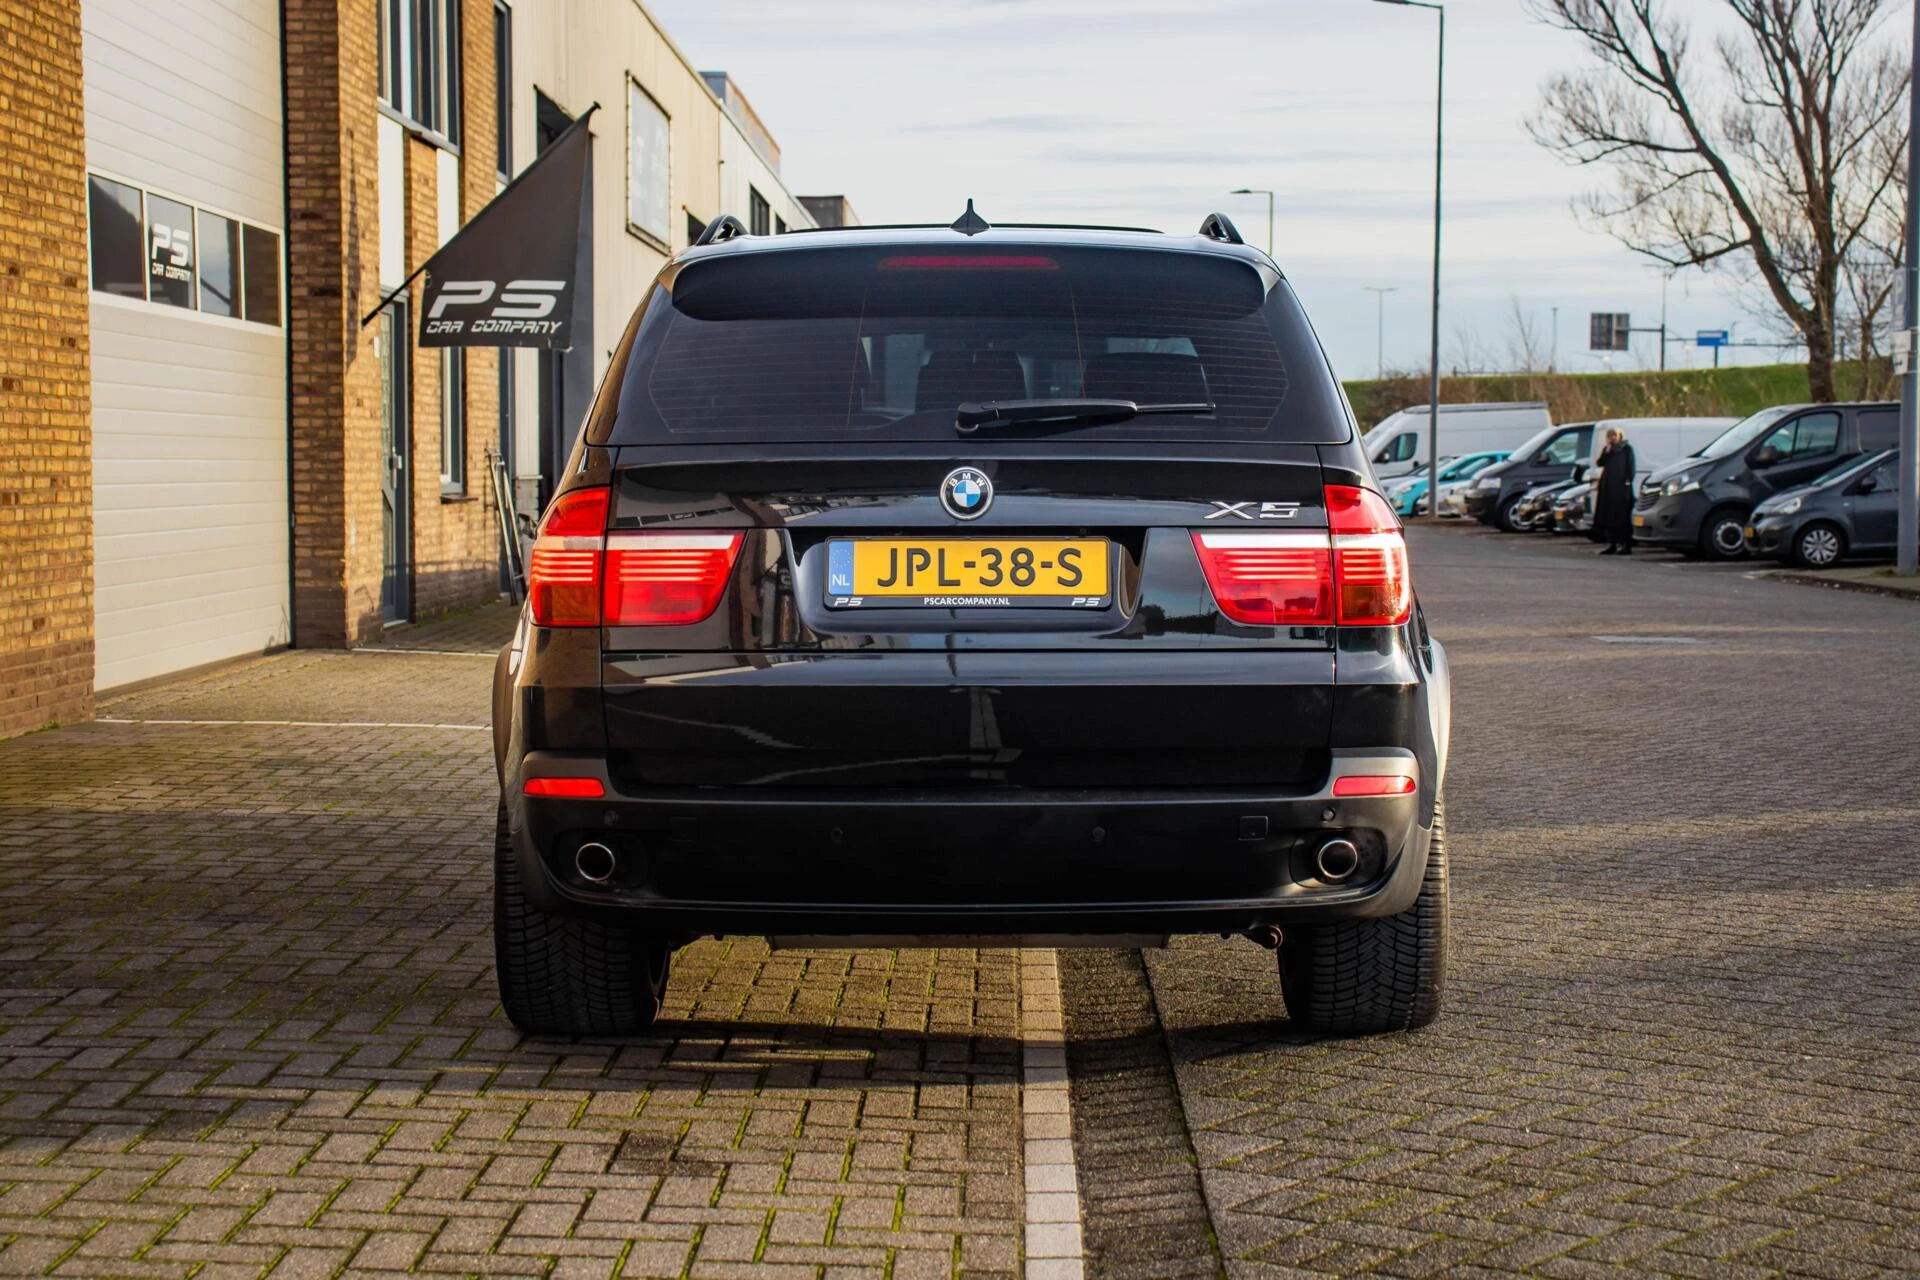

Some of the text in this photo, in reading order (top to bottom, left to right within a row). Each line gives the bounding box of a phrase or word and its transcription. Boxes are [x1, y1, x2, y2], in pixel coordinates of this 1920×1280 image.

[151, 223, 190, 267] PS
[428, 280, 566, 318] PS
[426, 320, 562, 334] CAR COMPANY
[949, 472, 985, 487] BMW
[1203, 501, 1301, 520] X5
[877, 547, 1083, 587] JPL-38-S
[831, 575, 850, 587] NL
[834, 597, 863, 607] PS
[923, 597, 1010, 607] PSCARCOMPANY.NL
[1071, 597, 1101, 607] PS
